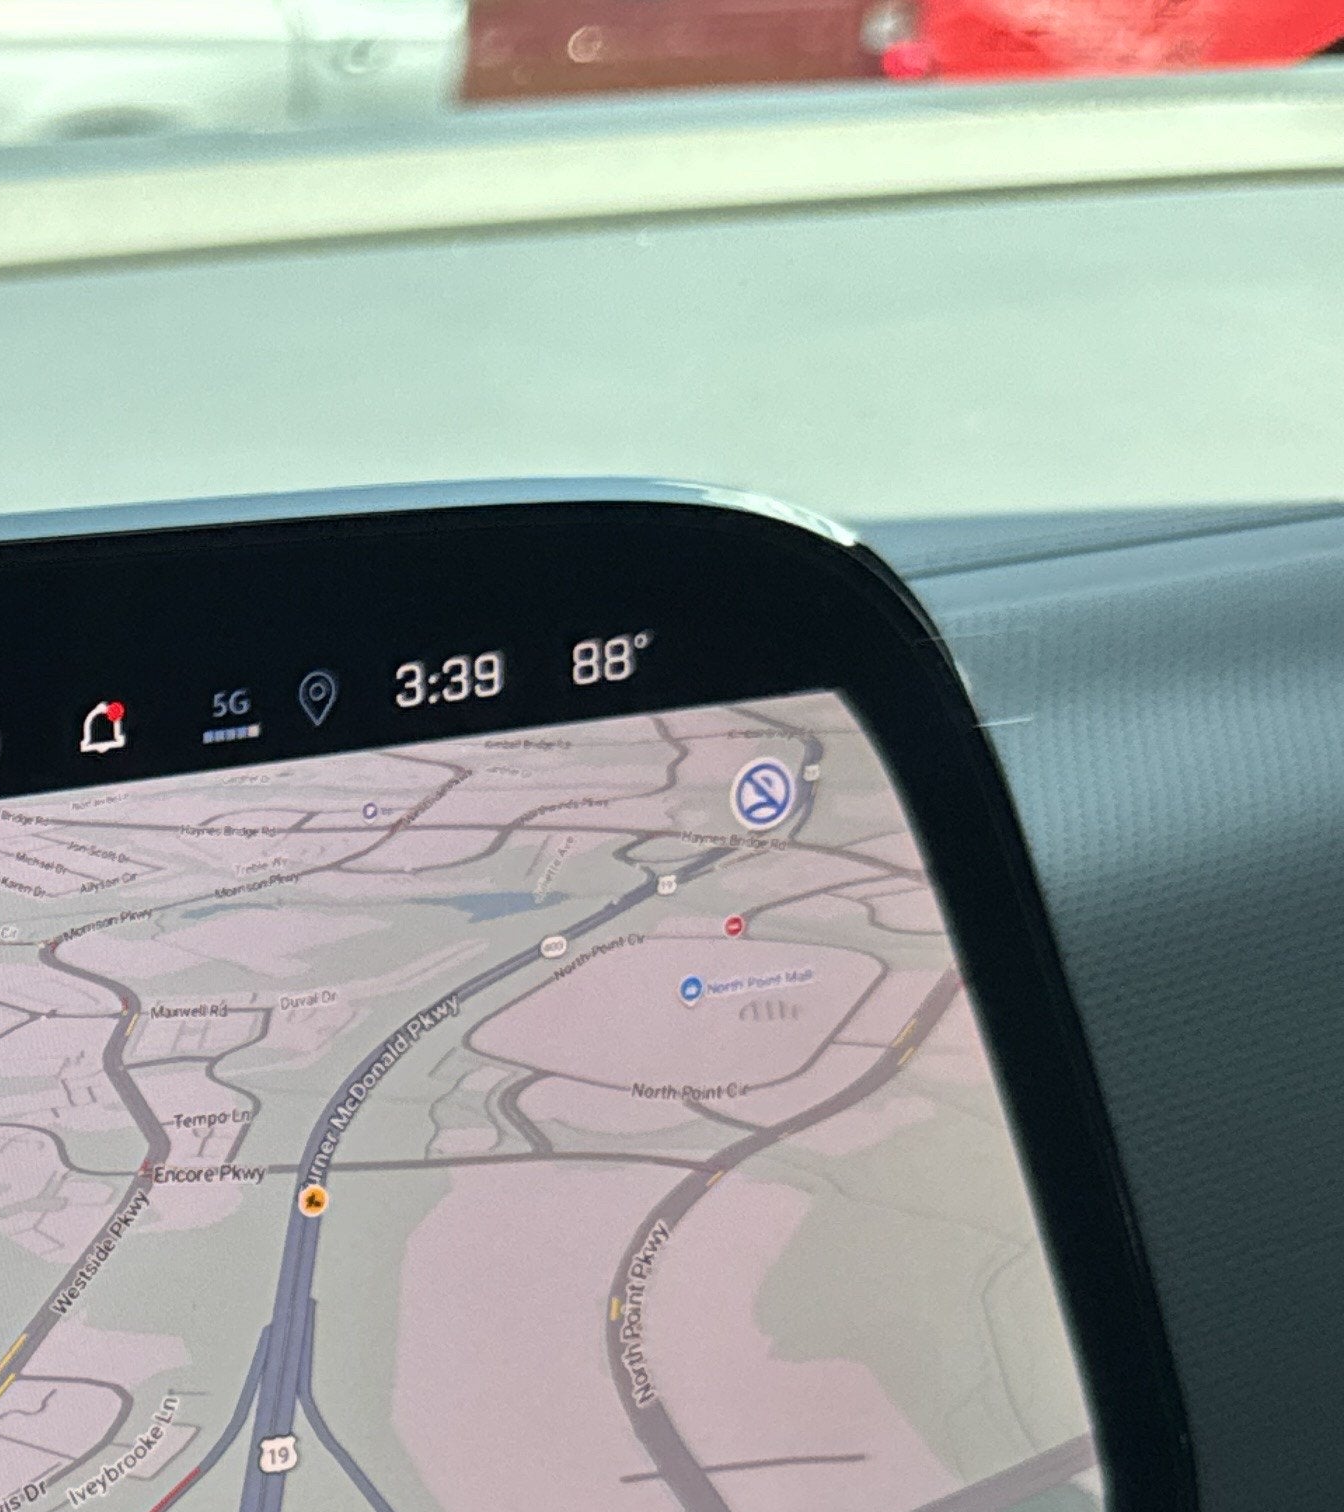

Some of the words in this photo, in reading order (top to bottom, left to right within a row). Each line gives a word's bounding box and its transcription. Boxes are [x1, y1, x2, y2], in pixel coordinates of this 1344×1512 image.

[395, 651, 505, 708] 3:39
[213, 690, 249, 717] 5G
[706, 977, 745, 995] North
[747, 972, 782, 989] Point
[209, 1004, 229, 1019] Rd
[308, 1123, 339, 1190] urner
[331, 1030, 411, 1132] McDonald
[406, 995, 462, 1040] Pkwy
[631, 1082, 678, 1100] North
[681, 1083, 723, 1102] Point
[173, 1112, 229, 1130] Tempo
[231, 1108, 252, 1123] Ln
[153, 1165, 216, 1184] Encore
[218, 1164, 267, 1186] Pkwy
[52, 1236, 115, 1316] Westside
[111, 1190, 151, 1240] Pkwy
[630, 1224, 671, 1281] Pkwy
[622, 1279, 645, 1343] Point
[623, 1342, 654, 1406] North
[68, 1421, 165, 1509] Iveybrooke
[159, 1395, 180, 1427] Ln
[267, 1446, 290, 1466] 19
[20, 1479, 49, 1504] Dr
